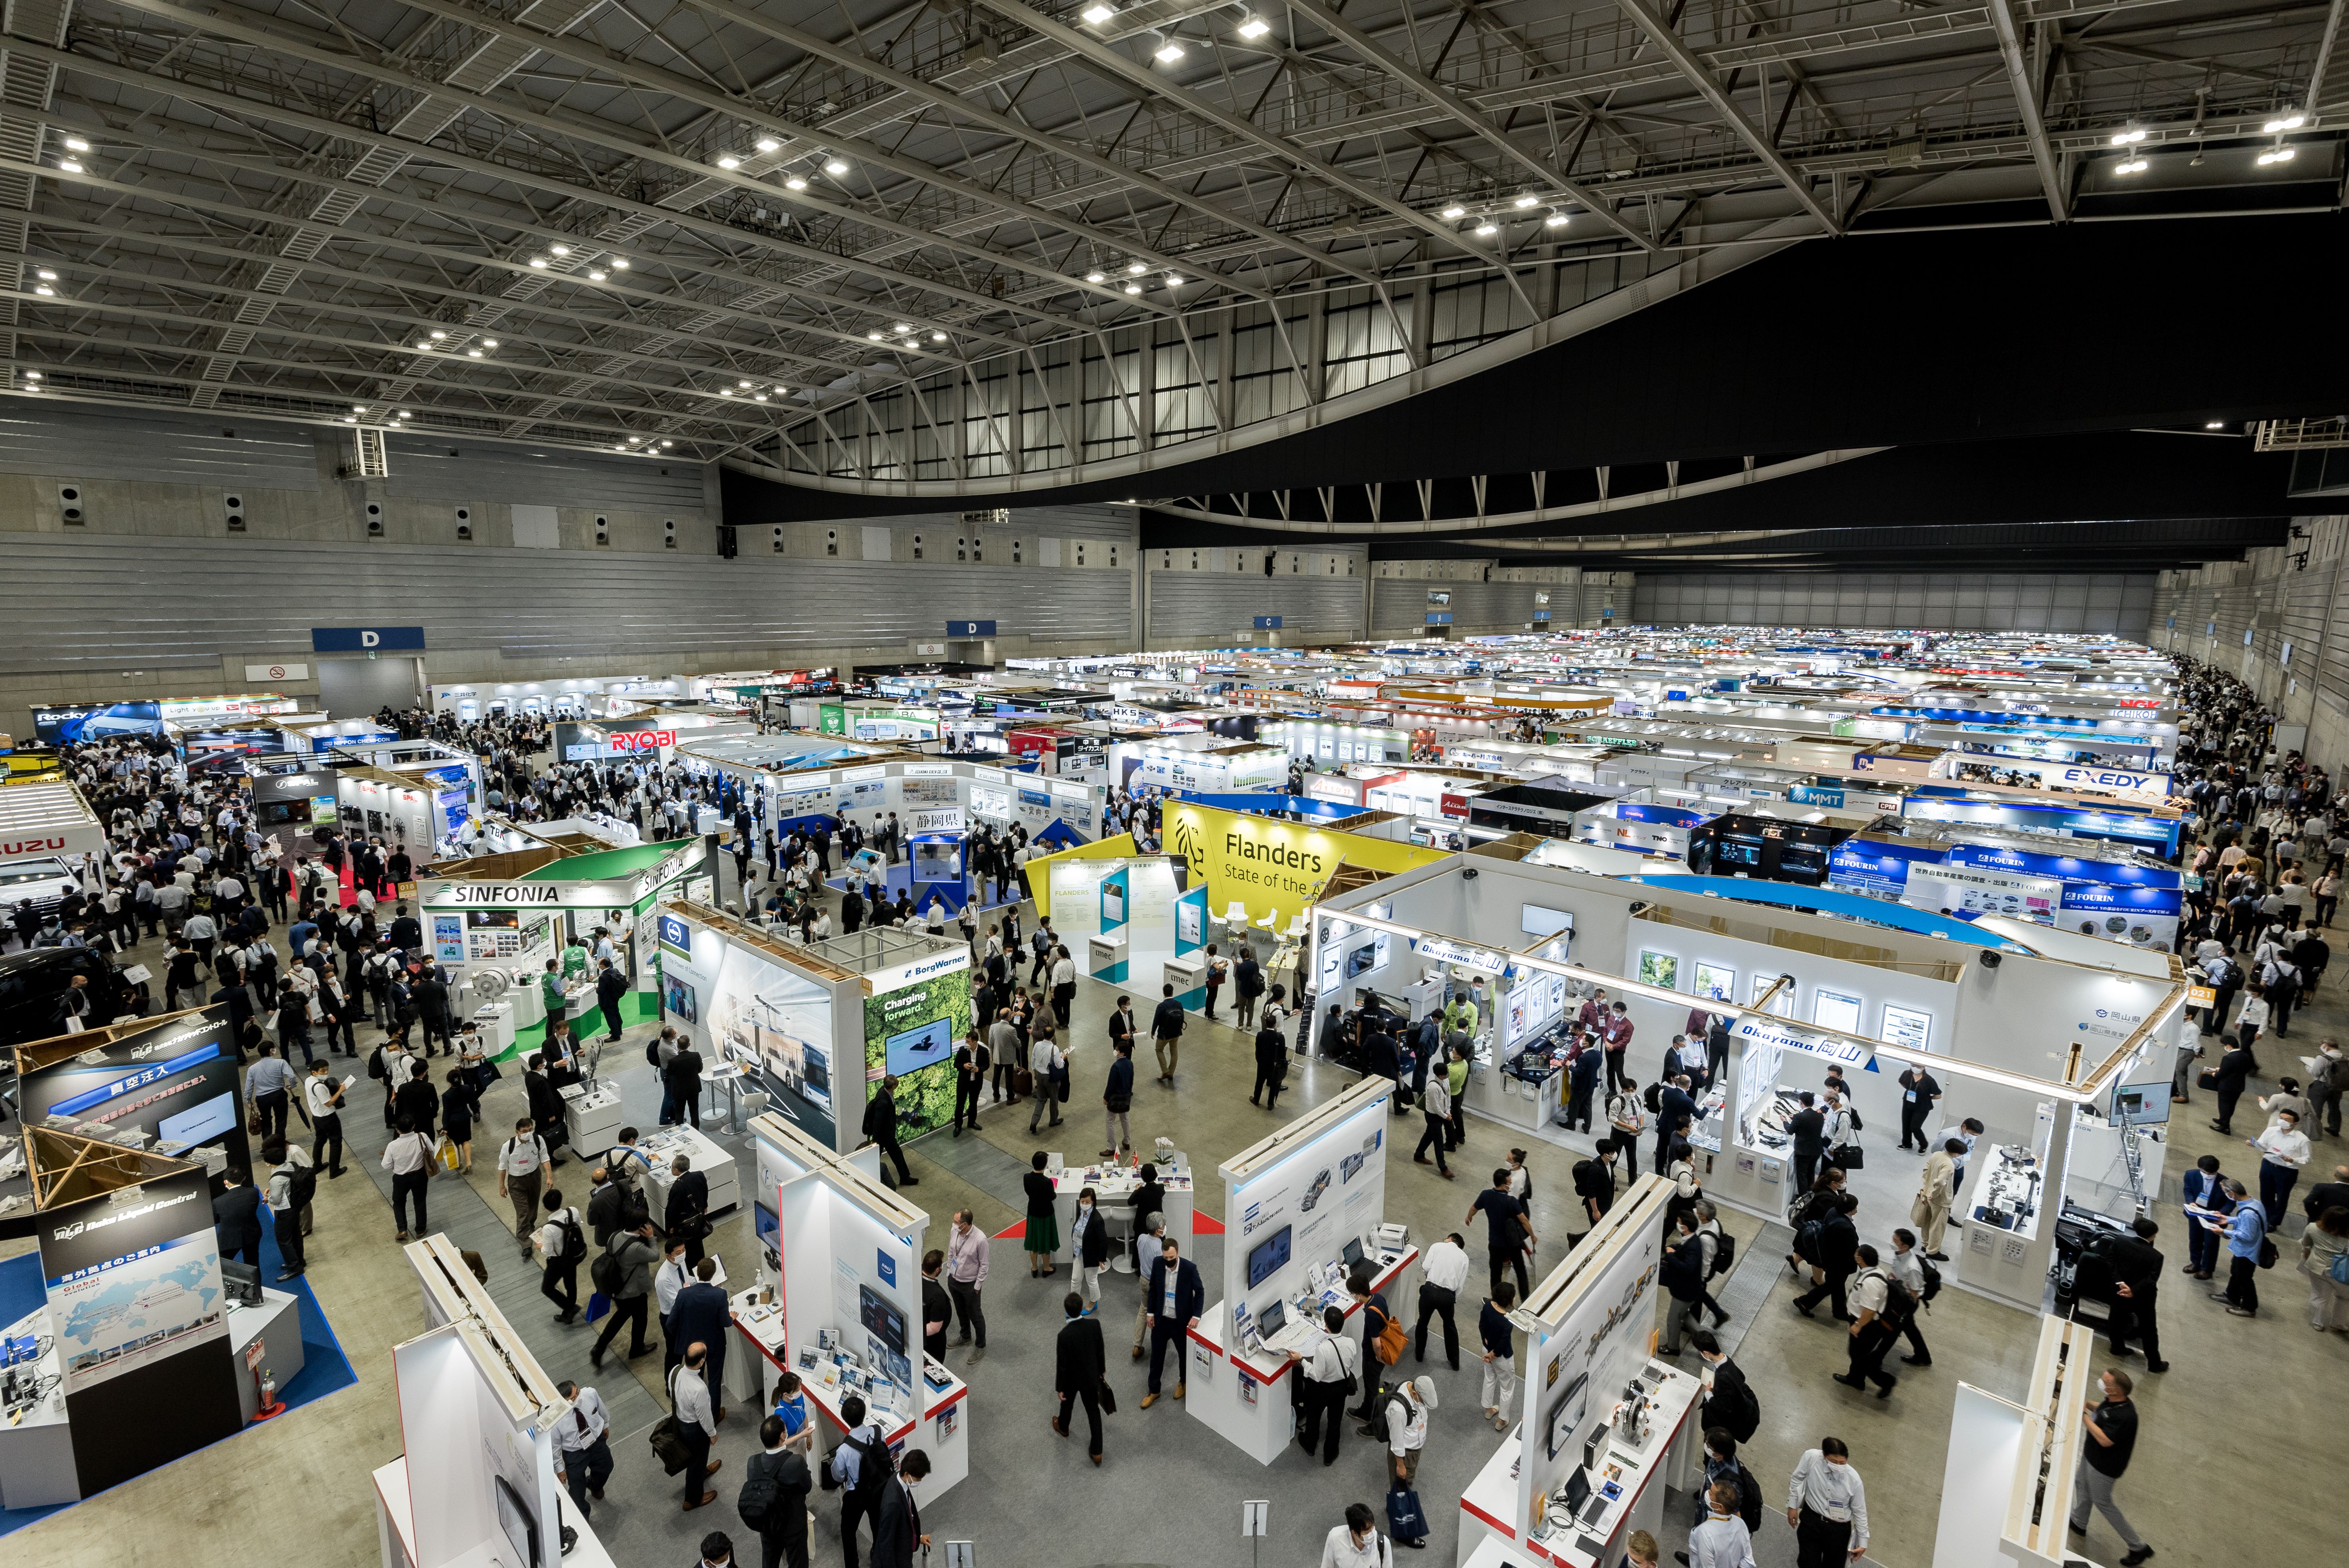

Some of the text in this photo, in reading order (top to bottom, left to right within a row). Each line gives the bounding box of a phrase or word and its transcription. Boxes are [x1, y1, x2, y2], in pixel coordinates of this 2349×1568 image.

[969, 624, 976, 633] D
[1266, 618, 1272, 627] C
[362, 631, 380, 647] D
[2120, 699, 2161, 709] NGK
[37, 712, 88, 721] Rocky
[610, 730, 676, 750] RYOBI
[1586, 735, 1636, 747] SCHAEFFLER
[685, 758, 710, 776] Mubea
[287, 778, 319, 787] SPAL
[1723, 779, 1754, 787] クレアクト
[2065, 769, 2150, 789] EXEDY
[1808, 793, 1841, 805] MMT
[917, 813, 958, 828] 静岡県
[1617, 828, 1631, 837] NL
[2136, 830, 2168, 838] Worldwide
[0, 837, 65, 855] UZU
[1226, 833, 1321, 873] Flanders
[1844, 859, 1878, 871] FOURIN
[1989, 856, 2025, 867] FOURIN
[645, 859, 684, 891] SINFONIA
[1225, 863, 1260, 884] State
[1264, 871, 1281, 888] of
[1284, 875, 1307, 895] the
[1915, 867, 2054, 893] 世界自動車産業の調査・出版 FOURIN
[456, 887, 559, 902] SINFONIA
[2076, 893, 2114, 902] FOURIN
[1095, 948, 1112, 960] imec
[1422, 944, 1501, 970] Okayama 岡山
[675, 959, 684, 970] Power
[689, 966, 707, 982] Connection
[915, 955, 966, 975] BorgWarner
[863, 980, 871, 988] 019
[1170, 974, 1189, 986] imec
[2191, 989, 2211, 998] 021
[884, 992, 926, 1011] Charging
[885, 1003, 923, 1022] forward.
[2111, 1011, 2141, 1024] 岡山県
[1742, 1025, 1862, 1061] Okayama 岡山
[110, 1065, 169, 1097] 真空注入
[1266, 1187, 1289, 1204] Pickering Interfaces
[86, 1191, 197, 1231] Naka Liquid Control
[1245, 1206, 1259, 1218] pickering
[61, 1245, 160, 1283] 海外拠点のご案内
[881, 1262, 891, 1271] SBD
[63, 1277, 99, 1293] Global
[64, 1283, 100, 1297] evolution
[1560, 1328, 1581, 1357] Continental
[1560, 1336, 1582, 1366] Engineering
[1559, 1352, 1575, 1374] Services
